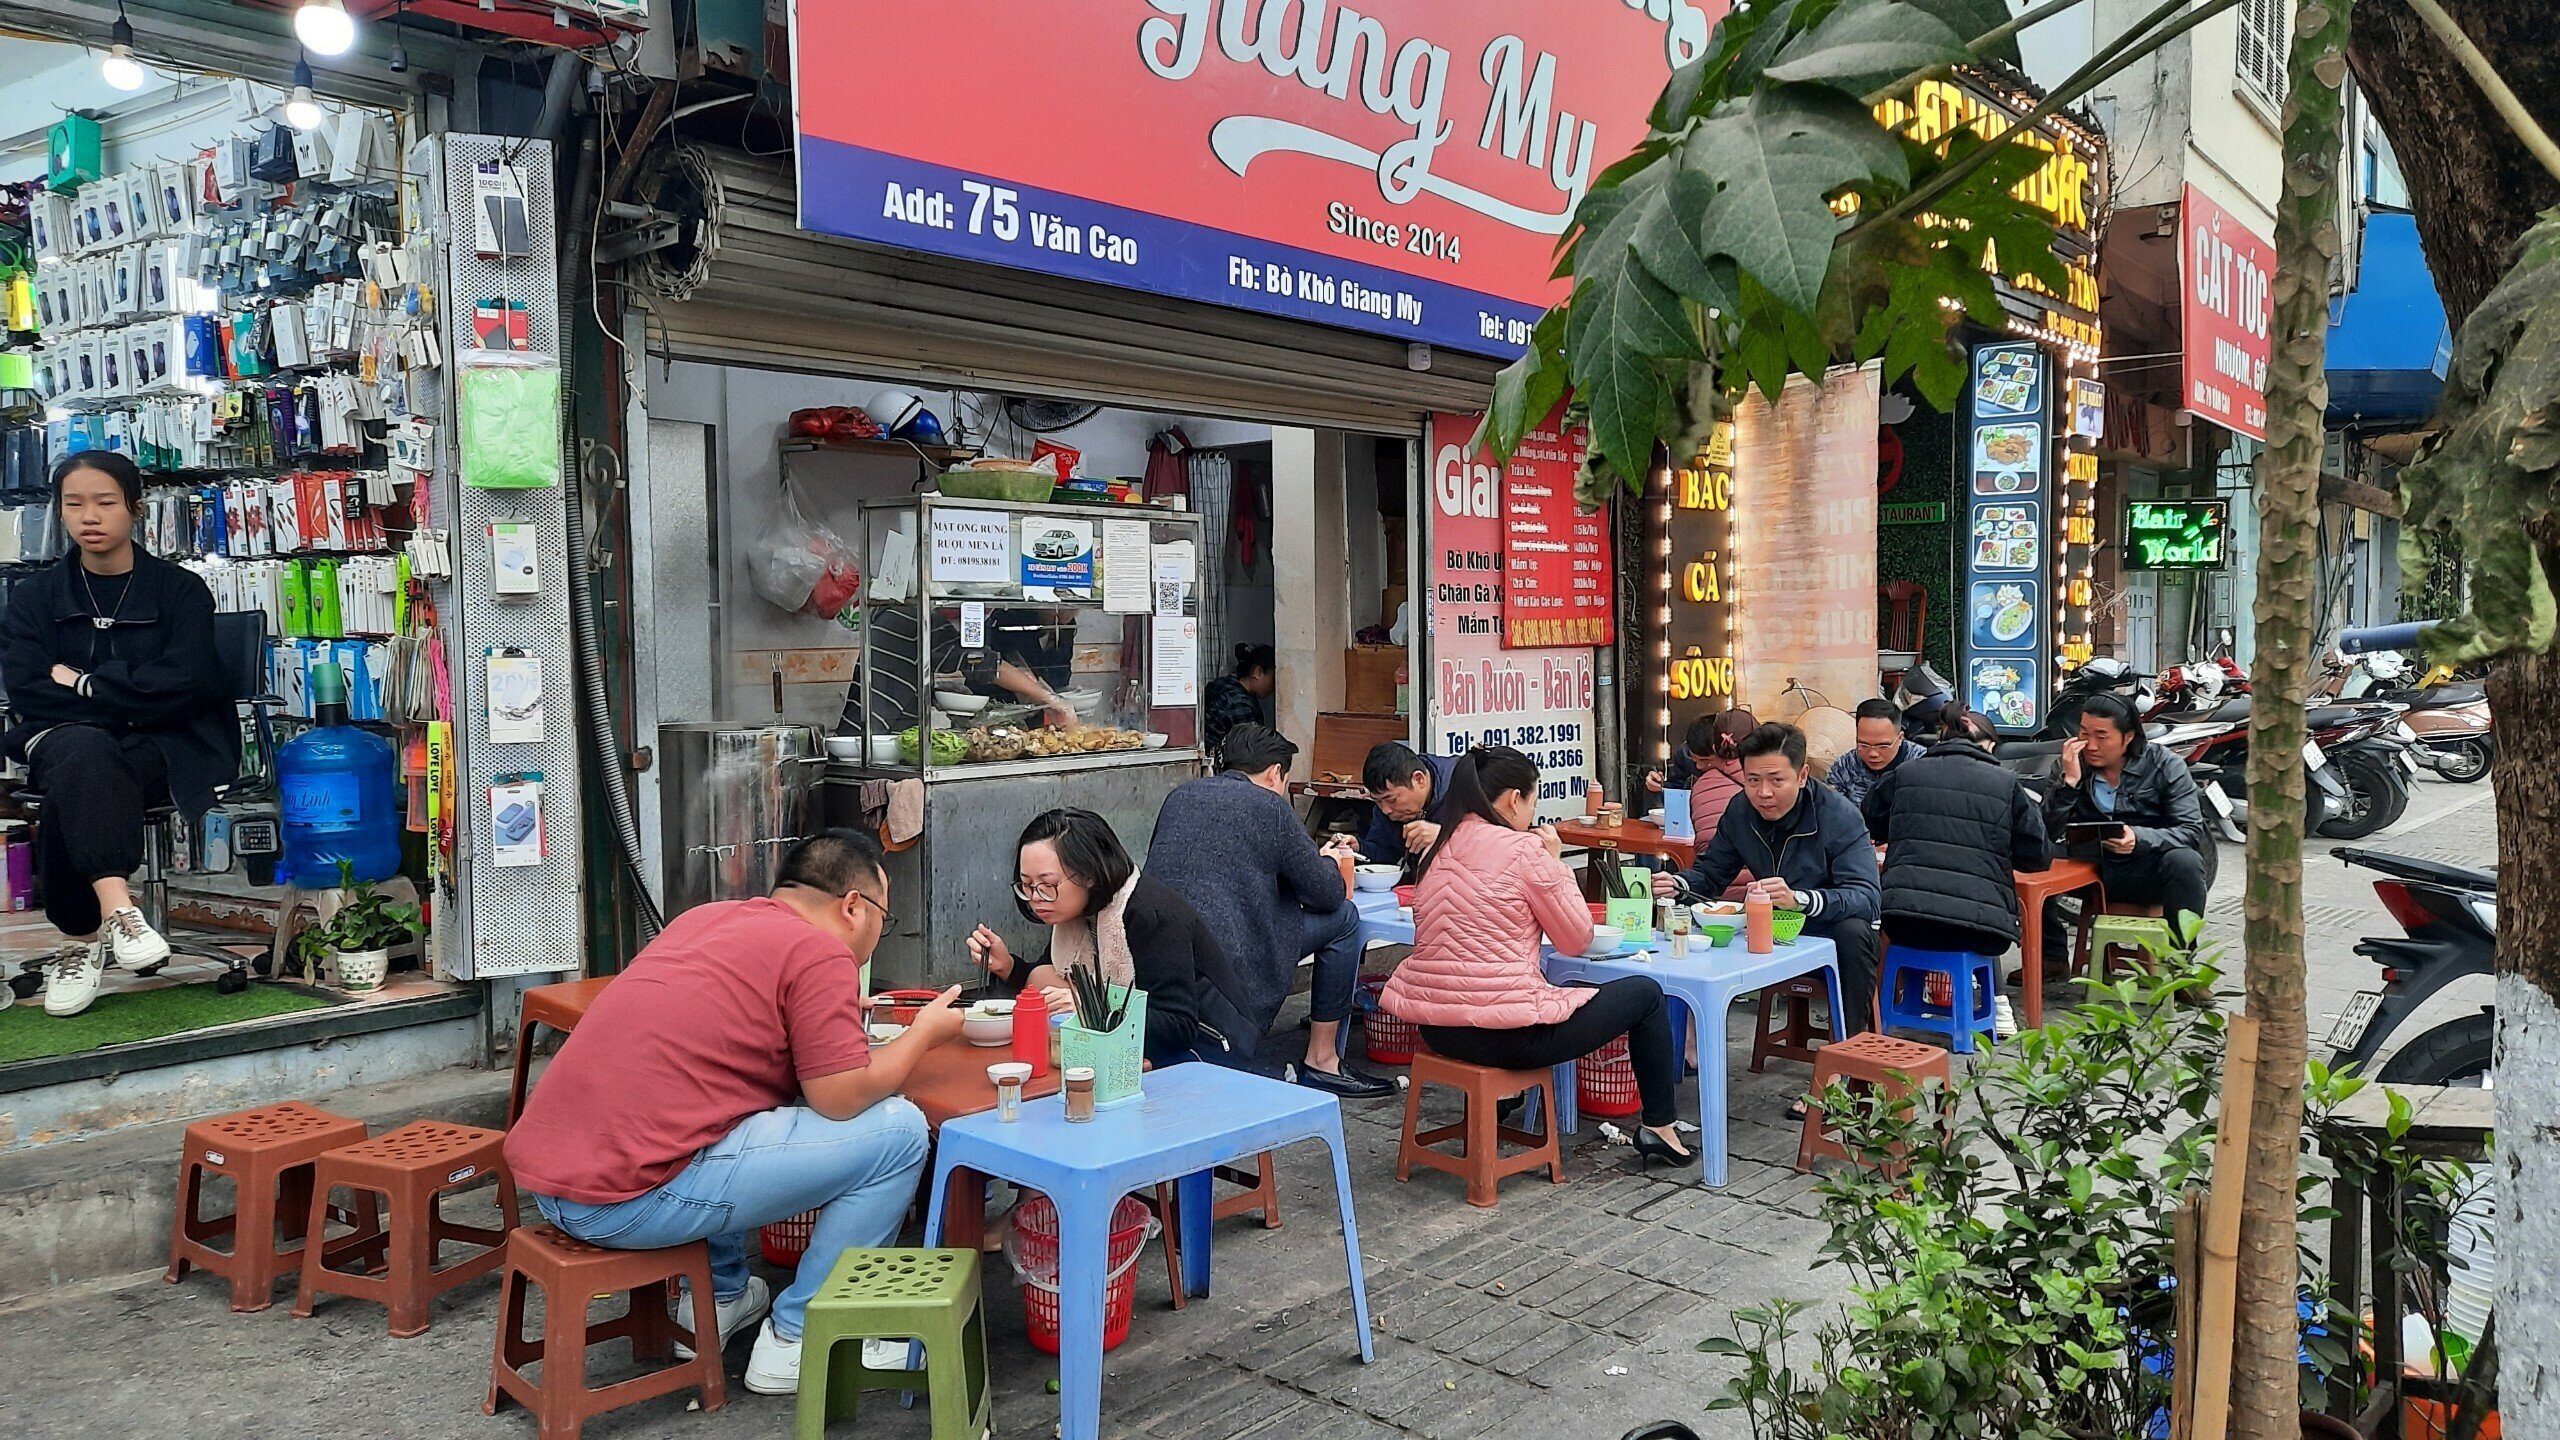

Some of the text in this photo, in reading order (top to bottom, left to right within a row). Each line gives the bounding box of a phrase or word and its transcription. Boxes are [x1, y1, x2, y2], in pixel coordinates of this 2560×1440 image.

[1480, 35, 1598, 232] My
[883, 179, 1138, 266] Add: 75 Văn Cao
[1327, 201, 1461, 264] Since 2014
[2195, 210, 2268, 340] CẮT TÓC
[1228, 256, 1423, 325] Fb: Bò Khô Giang My
[1478, 310, 1505, 341] Tel:
[957, 523, 978, 533] ONG
[2131, 504, 2188, 530] Hair
[968, 540, 989, 550] MEN
[2139, 536, 2221, 565] World
[1447, 550, 1463, 569] Bò
[1466, 550, 1490, 570] Khô
[1438, 583, 1471, 603] Chân
[1474, 583, 1490, 603] Gà
[1458, 611, 1490, 634] Mắm
[1674, 646, 1735, 698] SÔNG
[1442, 658, 1477, 717] Bán
[1481, 657, 1526, 714] Buôn
[1542, 656, 1573, 711] Bán
[1446, 723, 1581, 755] Tel: 091.382.1991
[430, 742, 440, 767] LOVE
[430, 768, 440, 794] LOVE
[1570, 775, 1589, 799] My
[430, 817, 438, 842] LOVE
